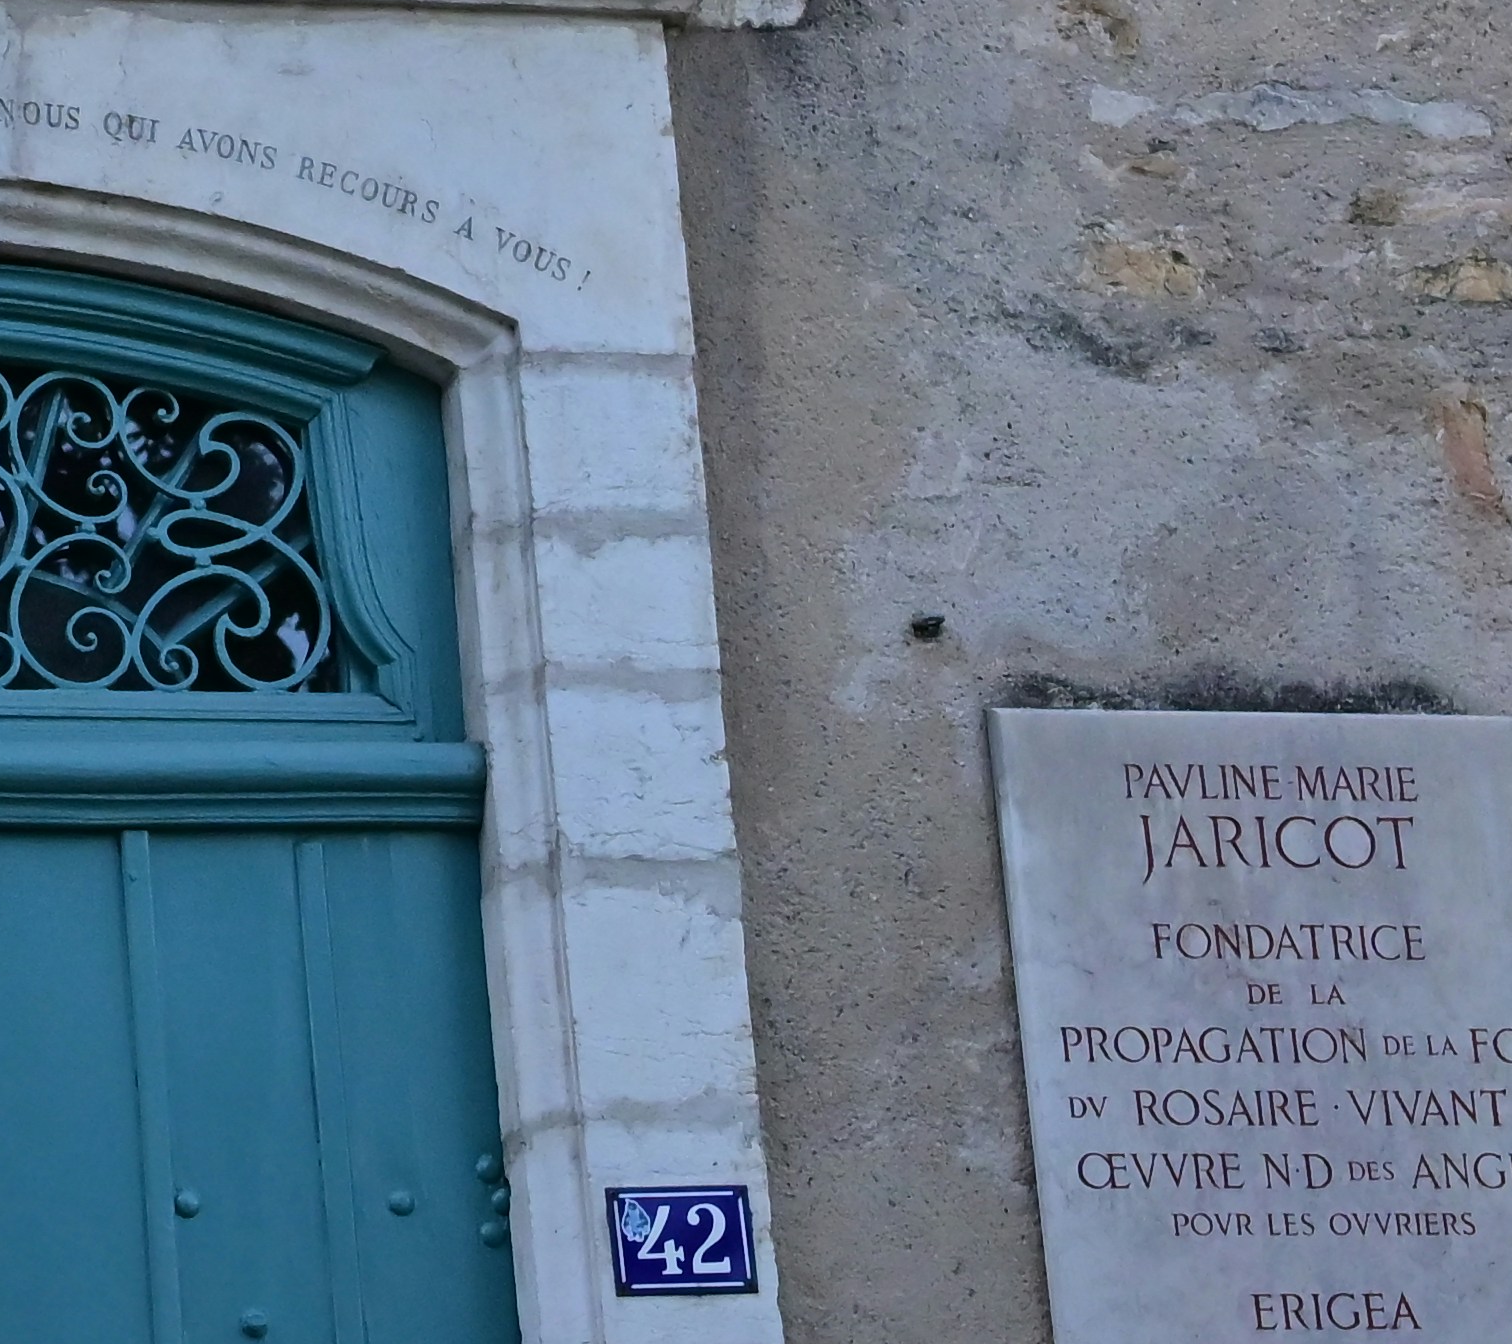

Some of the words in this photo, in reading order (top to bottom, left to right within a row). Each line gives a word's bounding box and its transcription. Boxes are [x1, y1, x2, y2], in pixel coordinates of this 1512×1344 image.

[102, 111, 160, 144] QUI
[176, 127, 277, 171] AVONS
[296, 156, 441, 225] RECOURS
[1139, 815, 1415, 886] JARICOT
[1151, 922, 1426, 962] FONDATRICE
[1247, 983, 1283, 1006] DE
[1310, 984, 1347, 1006] LA
[1059, 1025, 1368, 1064] PROPAGATION
[1383, 1035, 1416, 1057] DE
[1426, 1035, 1459, 1058] LA
[1133, 1088, 1320, 1127] ROSAIRE
[1346, 1088, 1508, 1128] VIVANT
[1348, 1161, 1395, 1182] DES
[637, 1203, 731, 1276] 42
[1172, 1212, 1254, 1238] POVR
[1266, 1212, 1315, 1237] LES
[1249, 1291, 1423, 1331] ERIGEA
